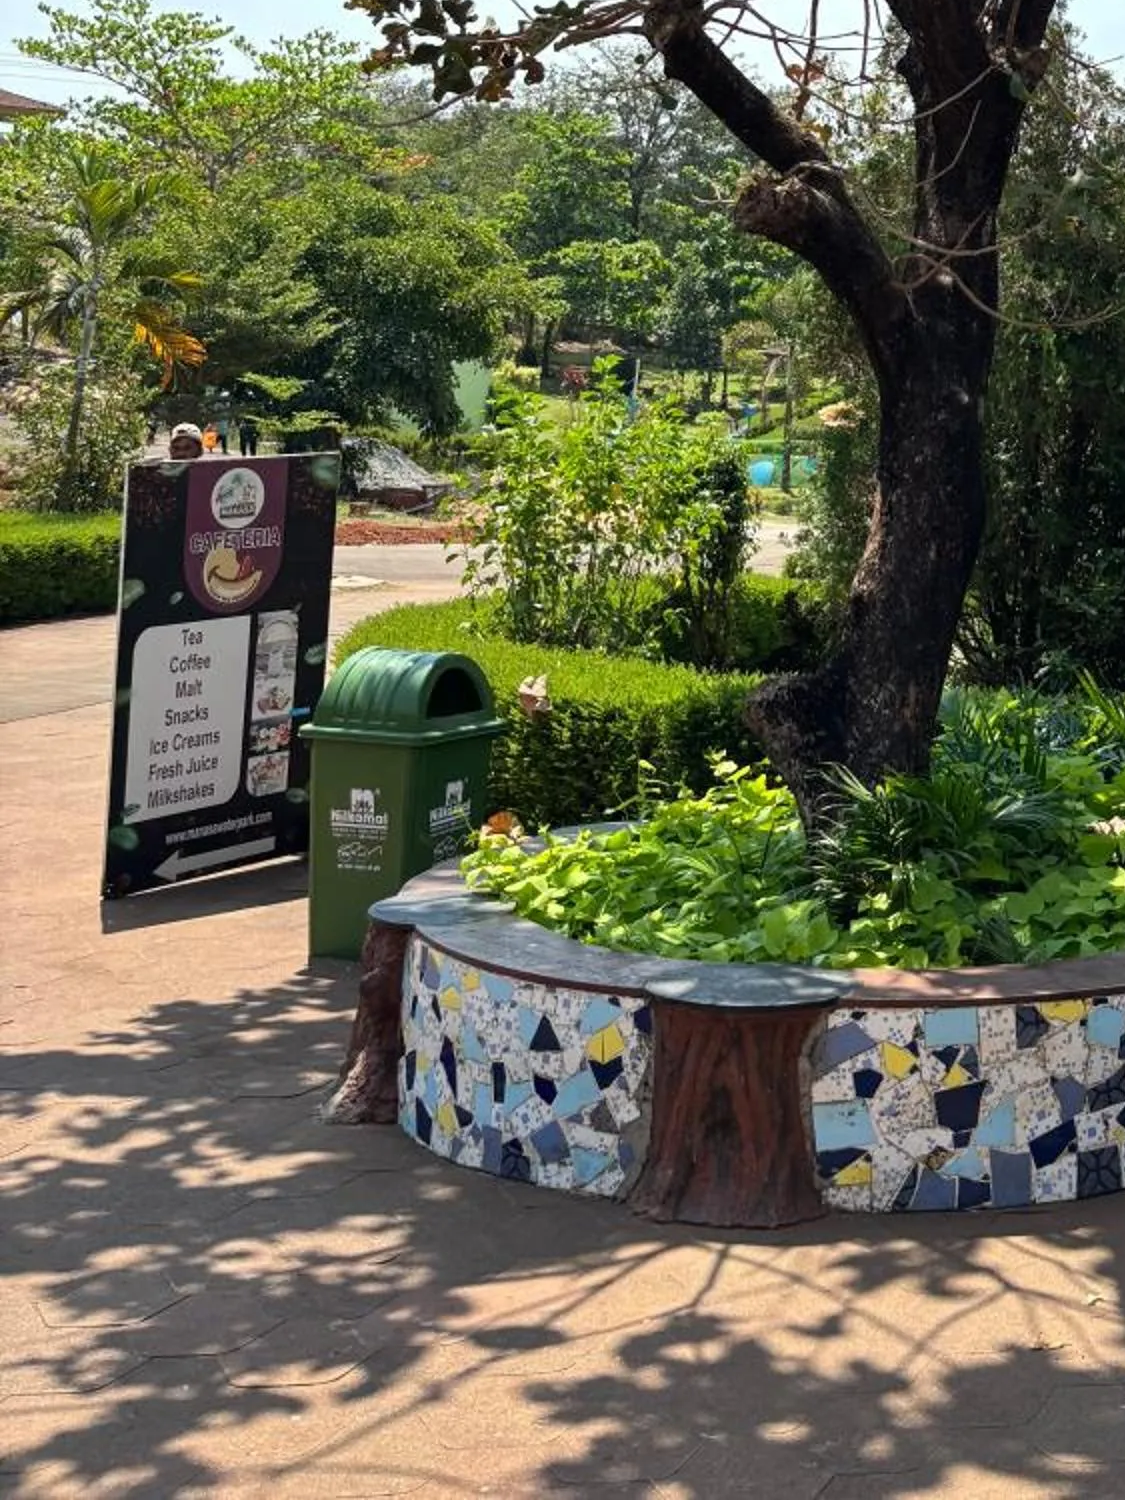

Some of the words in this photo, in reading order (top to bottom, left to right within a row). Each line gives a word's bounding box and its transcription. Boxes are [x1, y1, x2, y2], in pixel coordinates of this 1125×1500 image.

[190, 526, 281, 554] CAFETERIA
[182, 628, 203, 647] Tea
[169, 654, 211, 674] Coffee
[175, 679, 202, 698] Malt
[164, 705, 209, 727] Snacks
[149, 739, 168, 756] Ice
[173, 730, 220, 751] Creams
[148, 760, 184, 781] Fresh
[185, 756, 219, 774] Juice
[147, 781, 216, 809] Milkshakes
